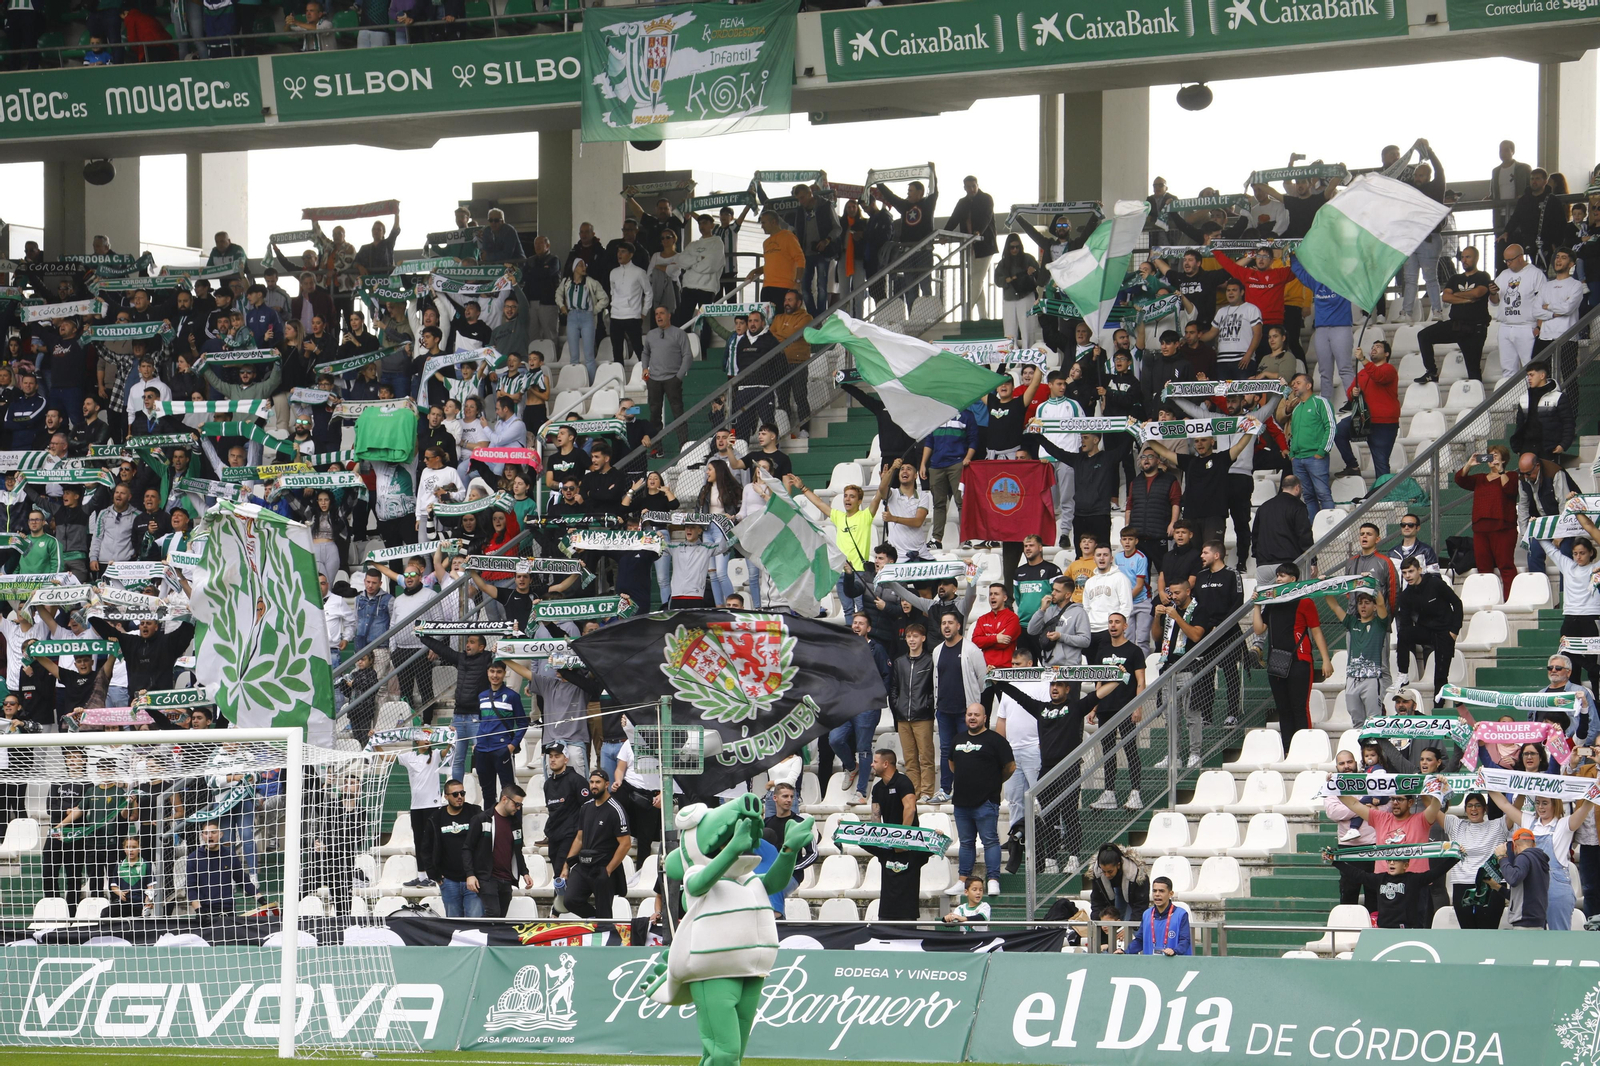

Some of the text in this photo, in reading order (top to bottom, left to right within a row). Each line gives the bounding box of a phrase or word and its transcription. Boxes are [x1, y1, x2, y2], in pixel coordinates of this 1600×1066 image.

[1259, 0, 1379, 25] CaixaBank
[1545, 0, 1560, 10] de
[720, 16, 744, 38] PEÑA
[1065, 6, 1180, 42] CaixaBank
[880, 23, 990, 56] CaixaBank
[710, 49, 752, 66] Infantil
[483, 57, 582, 85] SILBO
[313, 67, 433, 98] SILBON
[96, 324, 160, 337] CÓRDOBA CF
[1149, 421, 1215, 436] CÓRDOBA
[1216, 421, 1234, 432] CF
[473, 448, 532, 460] CÓRDOBA GIRLS
[261, 464, 298, 474] LAS PALMAS
[284, 475, 334, 486] CÓRDOBA
[171, 553, 200, 566] CÓRDOB
[469, 557, 516, 570] Defend
[38, 588, 92, 601] CÓRDOBA
[538, 602, 615, 617] CÓRDOBA CF
[29, 641, 89, 655] CÓRDOBA
[100, 715, 147, 723] CORDOBSA
[1364, 716, 1452, 731] CÓRDOBA
[715, 694, 821, 767] CÓRDOBA
[1496, 724, 1531, 732] MUJER
[1483, 731, 1543, 741] CORDOBESA
[1326, 775, 1421, 792] CÓRDOBA CF
[1508, 775, 1565, 793] VOLVEREMOS
[843, 822, 926, 842] CÓRDOBA
[834, 966, 967, 981] BODEGA Y VIÑEDOS
[749, 954, 962, 1050] Barquero
[94, 982, 445, 1040] GIVOVA
[1012, 968, 1505, 1065] el Día DE CÓRDOBA
